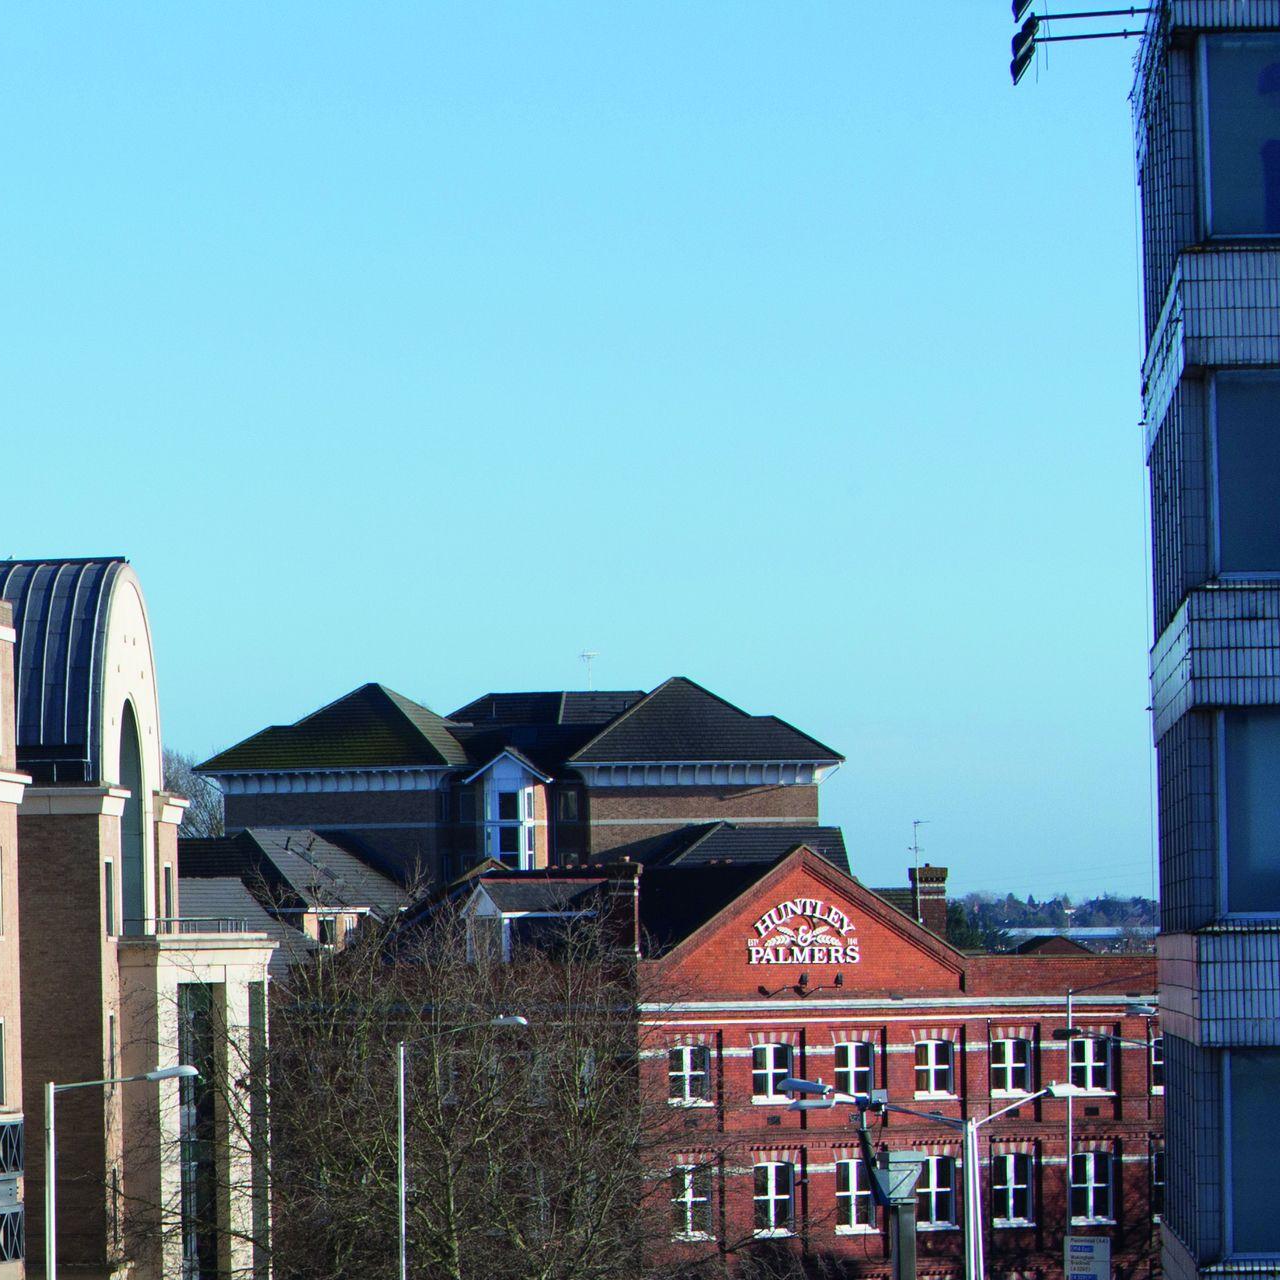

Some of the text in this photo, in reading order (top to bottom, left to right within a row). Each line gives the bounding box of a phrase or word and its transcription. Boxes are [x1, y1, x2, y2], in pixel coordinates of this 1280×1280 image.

[753, 898, 856, 938] HUNTLEY
[797, 925, 813, 947] &
[749, 947, 860, 964] PALMERS
